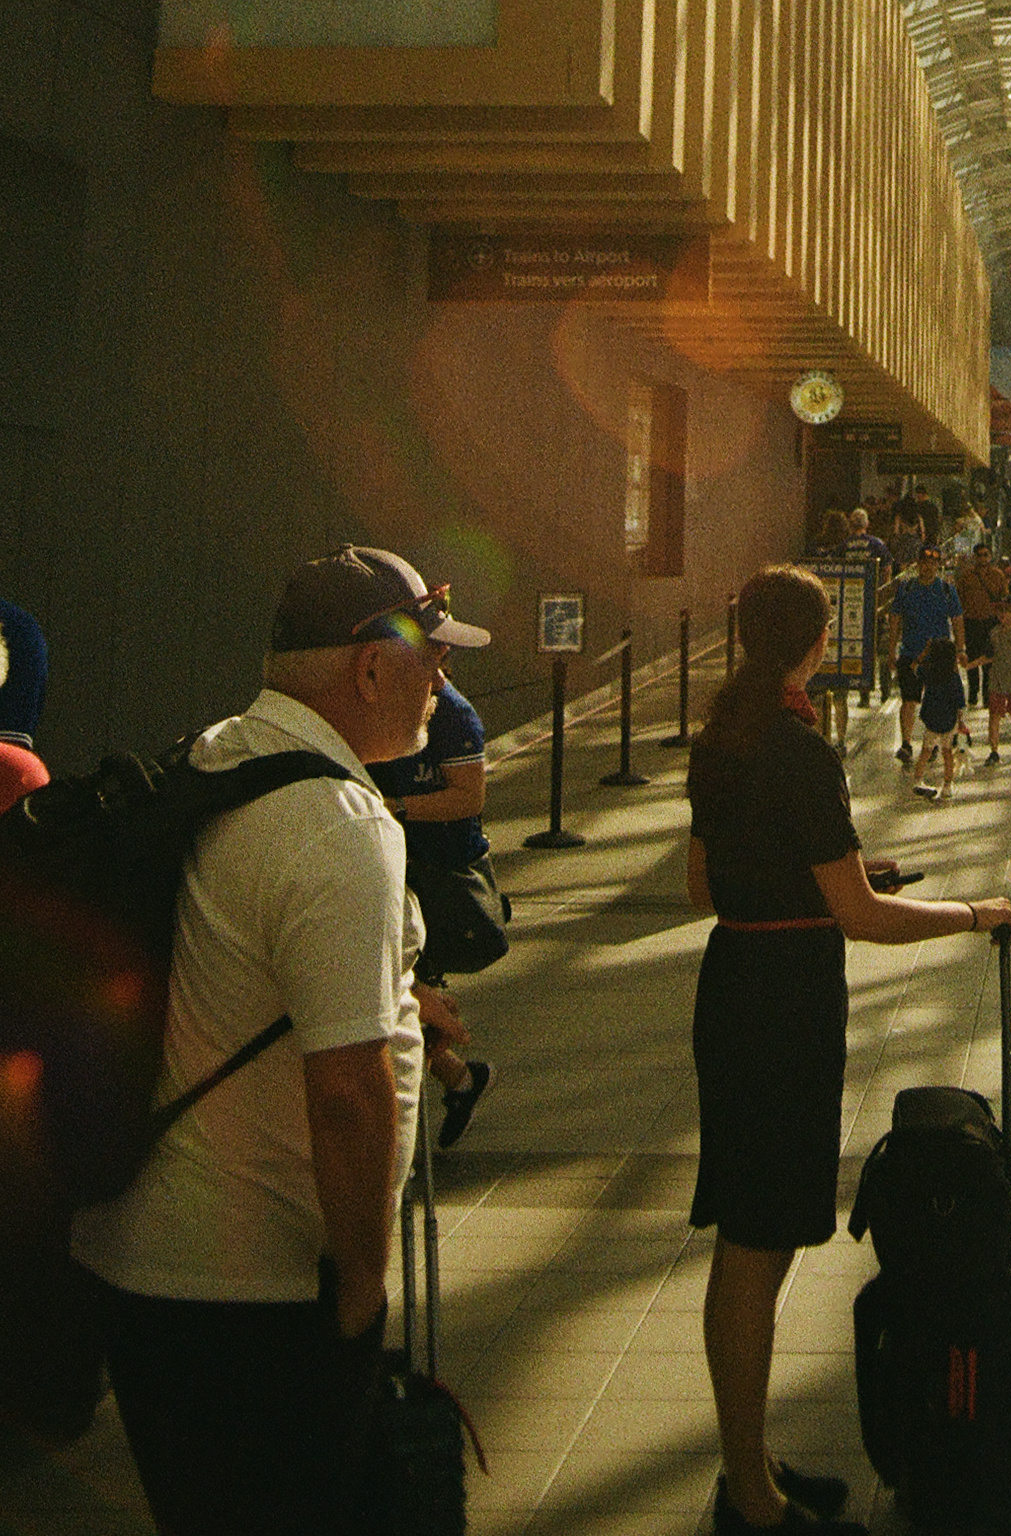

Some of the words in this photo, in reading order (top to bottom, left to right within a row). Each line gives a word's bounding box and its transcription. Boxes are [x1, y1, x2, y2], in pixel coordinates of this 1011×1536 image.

[503, 249, 550, 264] Trains
[553, 250, 570, 264] to
[574, 249, 631, 266] Airport
[502, 272, 549, 287] Trains
[552, 275, 585, 287] vers
